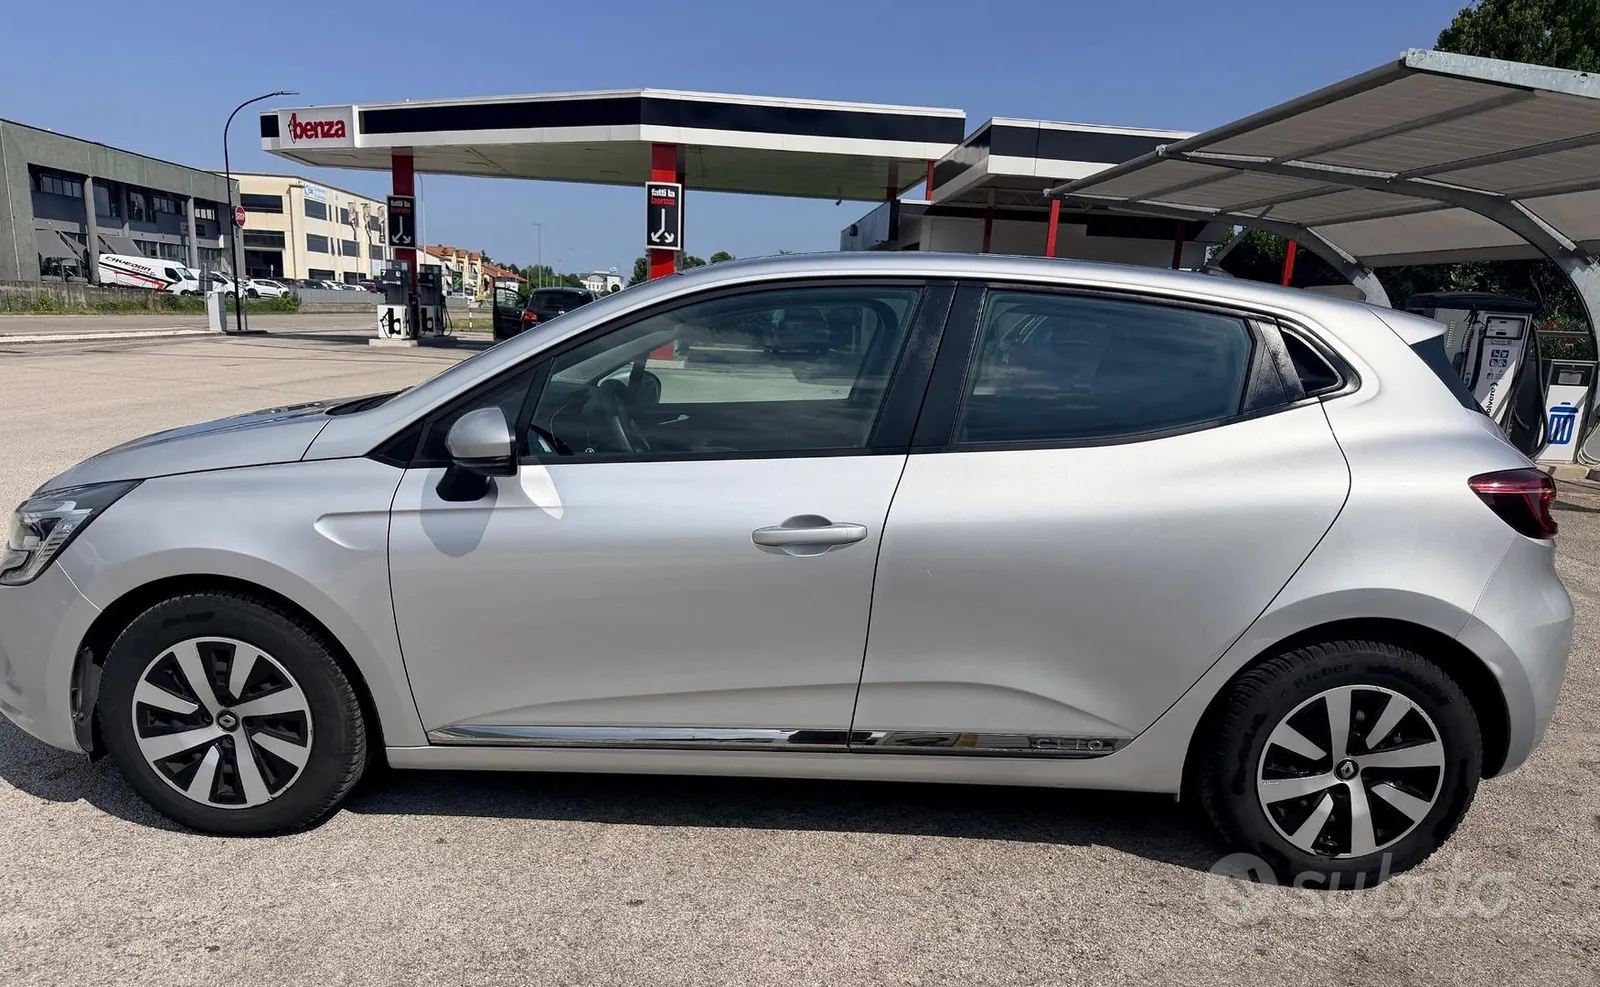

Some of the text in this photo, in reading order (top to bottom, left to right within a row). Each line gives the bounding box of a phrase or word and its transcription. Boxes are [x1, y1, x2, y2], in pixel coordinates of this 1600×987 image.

[290, 112, 346, 140] benza
[651, 188, 676, 198] fatti la
[1036, 738, 1104, 750] CLIO
